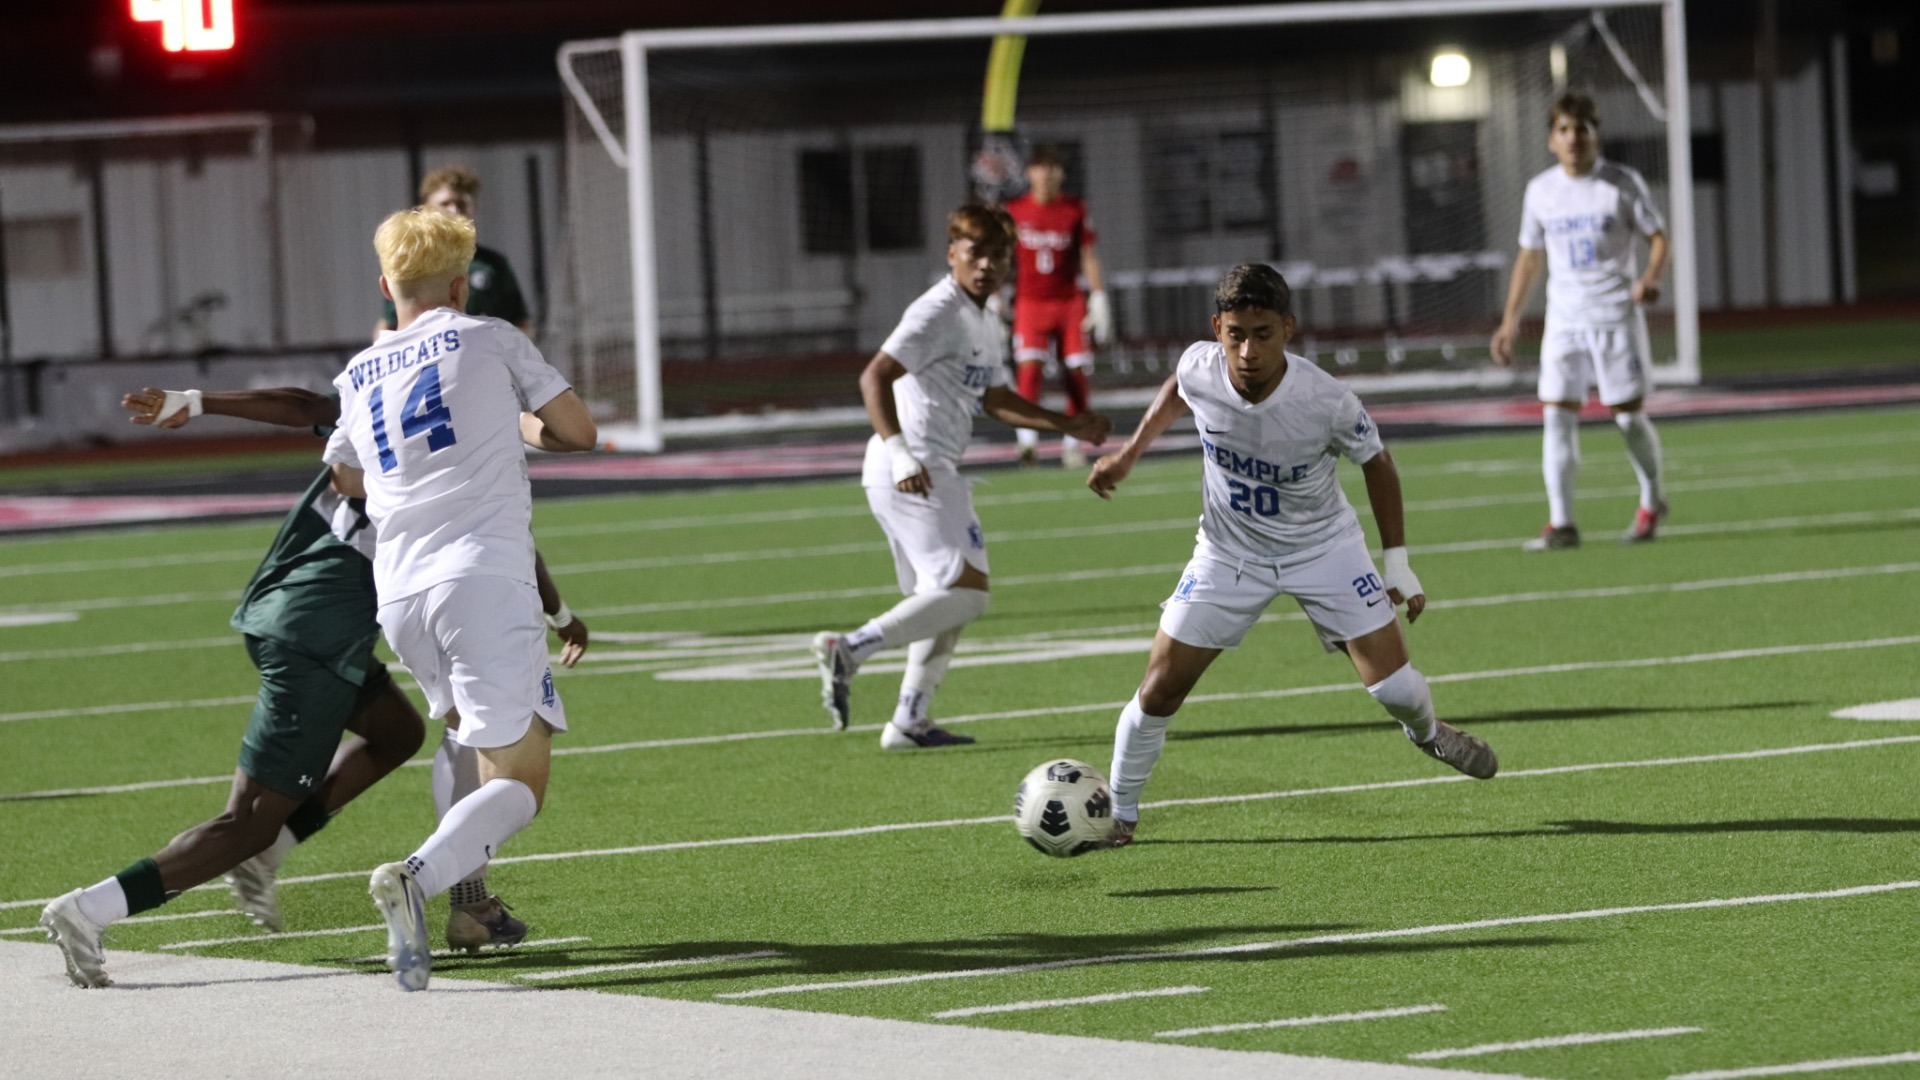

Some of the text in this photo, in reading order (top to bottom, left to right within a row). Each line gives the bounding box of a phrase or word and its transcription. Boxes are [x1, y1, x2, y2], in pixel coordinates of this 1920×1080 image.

[1570, 238, 1596, 269] 13
[349, 329, 460, 392] WILDCATS
[368, 363, 457, 473] 14
[1202, 438, 1308, 483] TEMPLE
[1228, 479, 1280, 516] 20
[1352, 573, 1382, 598] 20
